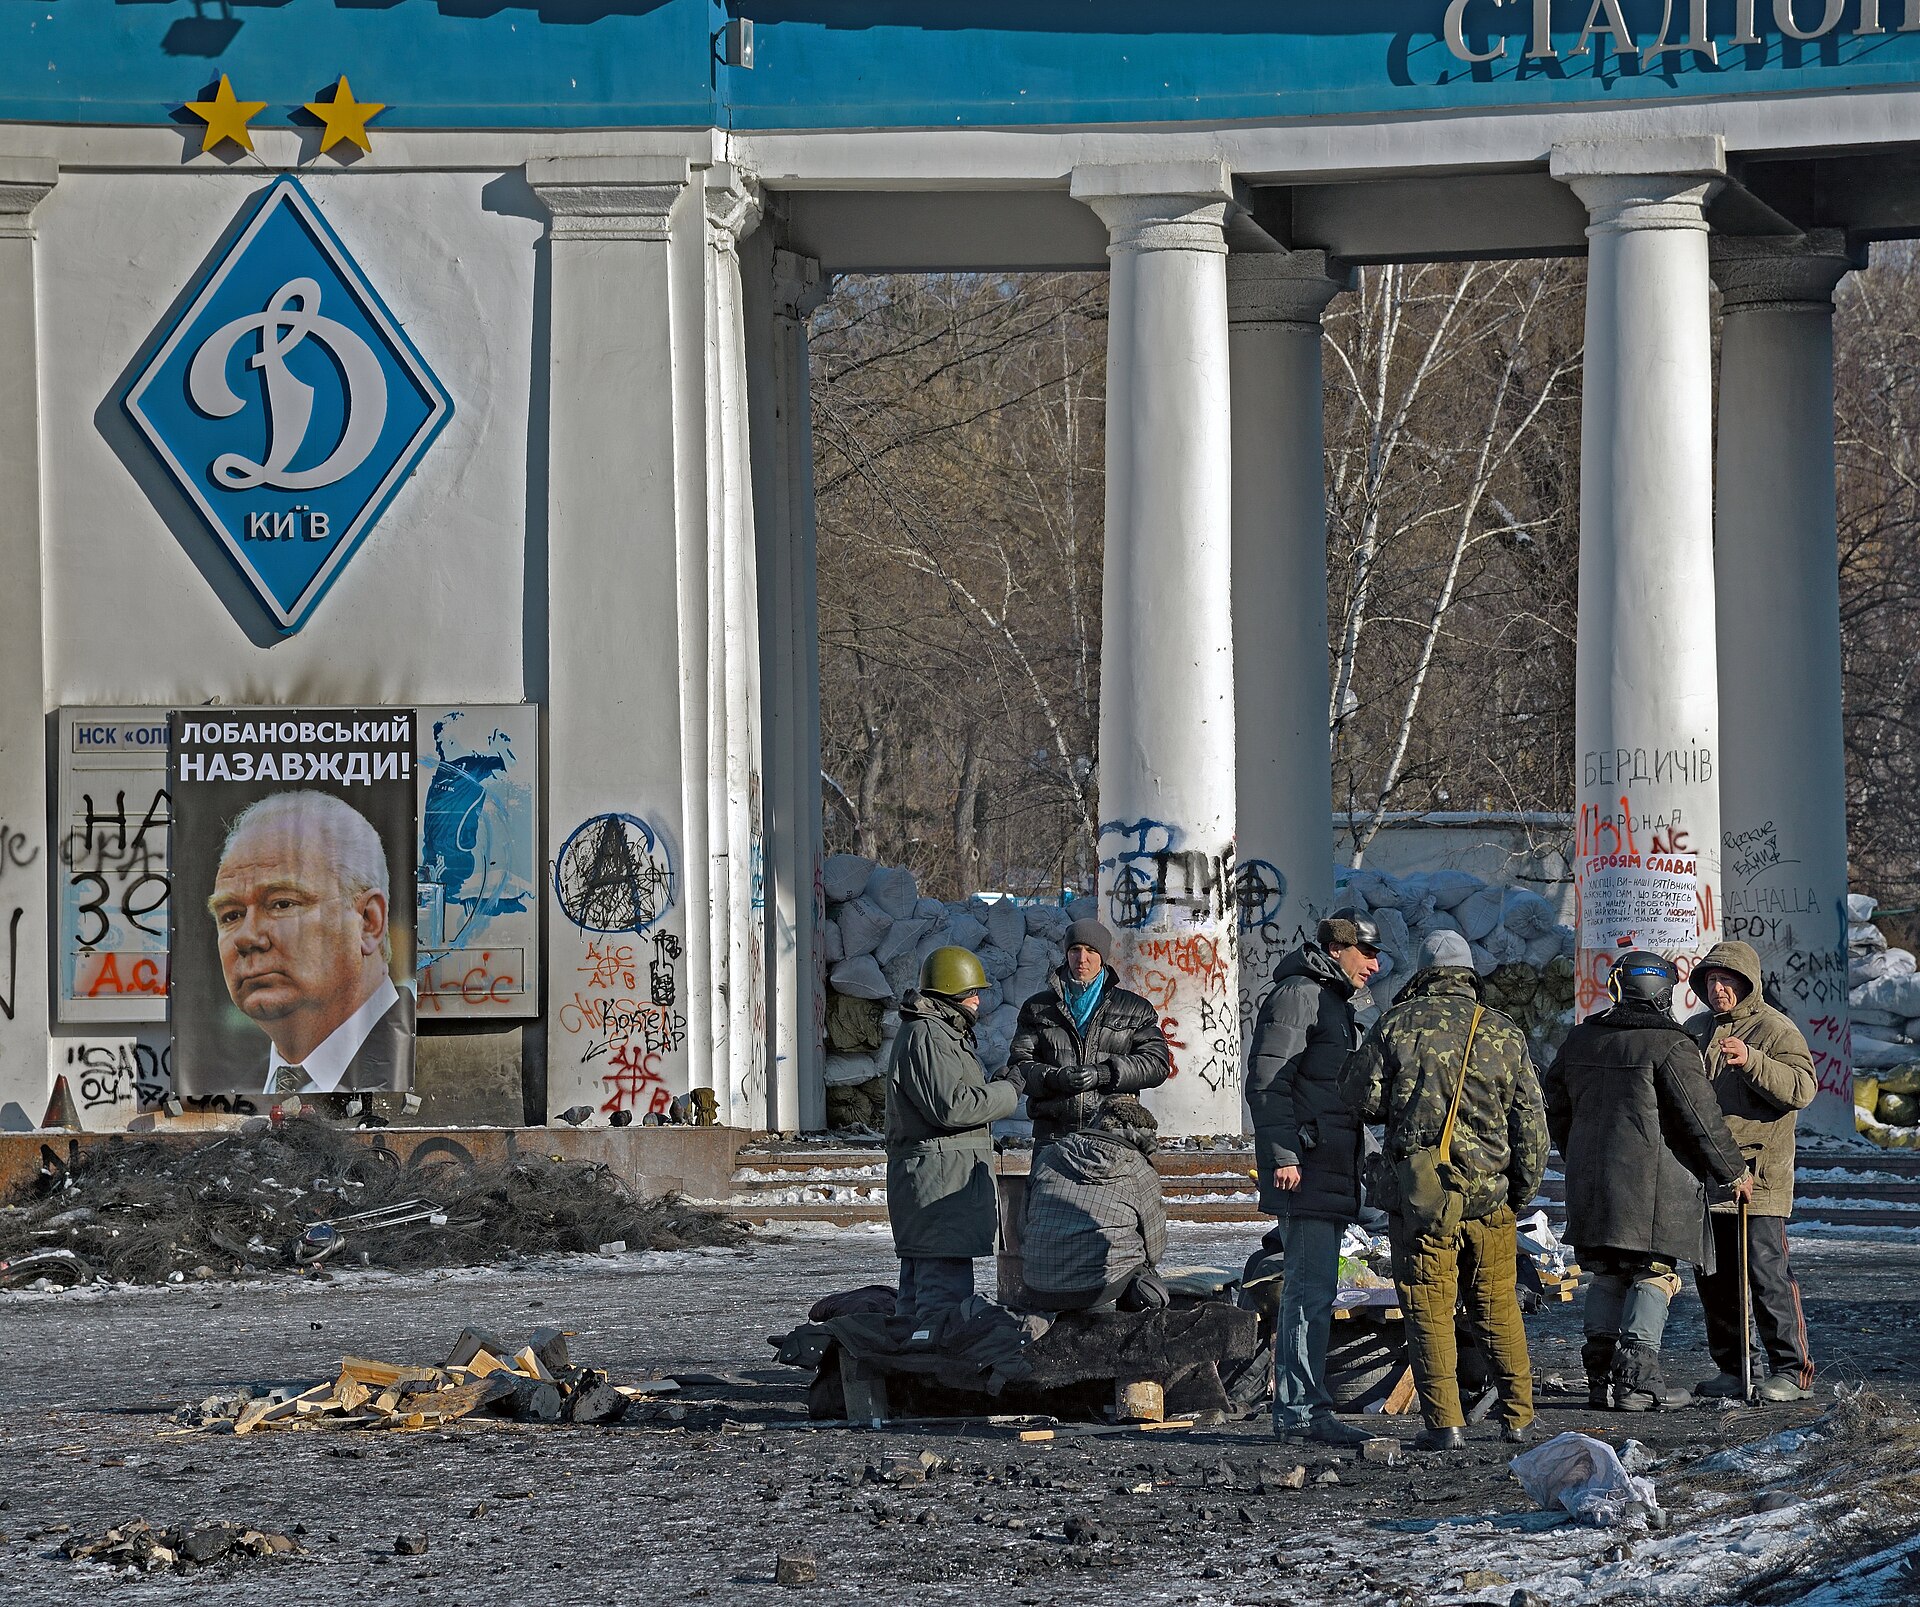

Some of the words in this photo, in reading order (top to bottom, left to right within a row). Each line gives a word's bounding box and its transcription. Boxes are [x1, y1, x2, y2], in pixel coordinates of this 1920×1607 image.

[251, 505, 330, 538] КИВ
[79, 728, 117, 744] НСК
[180, 715, 410, 744] ЛОБАНОВСЬКИЙ
[180, 752, 410, 786] НАЗАВЖДИ!
[1585, 738, 1712, 788] БЕРДИЧІВ
[1585, 855, 1641, 877] ГЕРОЯМ
[1645, 856, 1697, 877] СЛАВА!
[1651, 891, 1692, 902] БОРИТЕСЬ
[1722, 888, 1821, 914] VALHALLA
[645, 1031, 686, 1055] БАР
